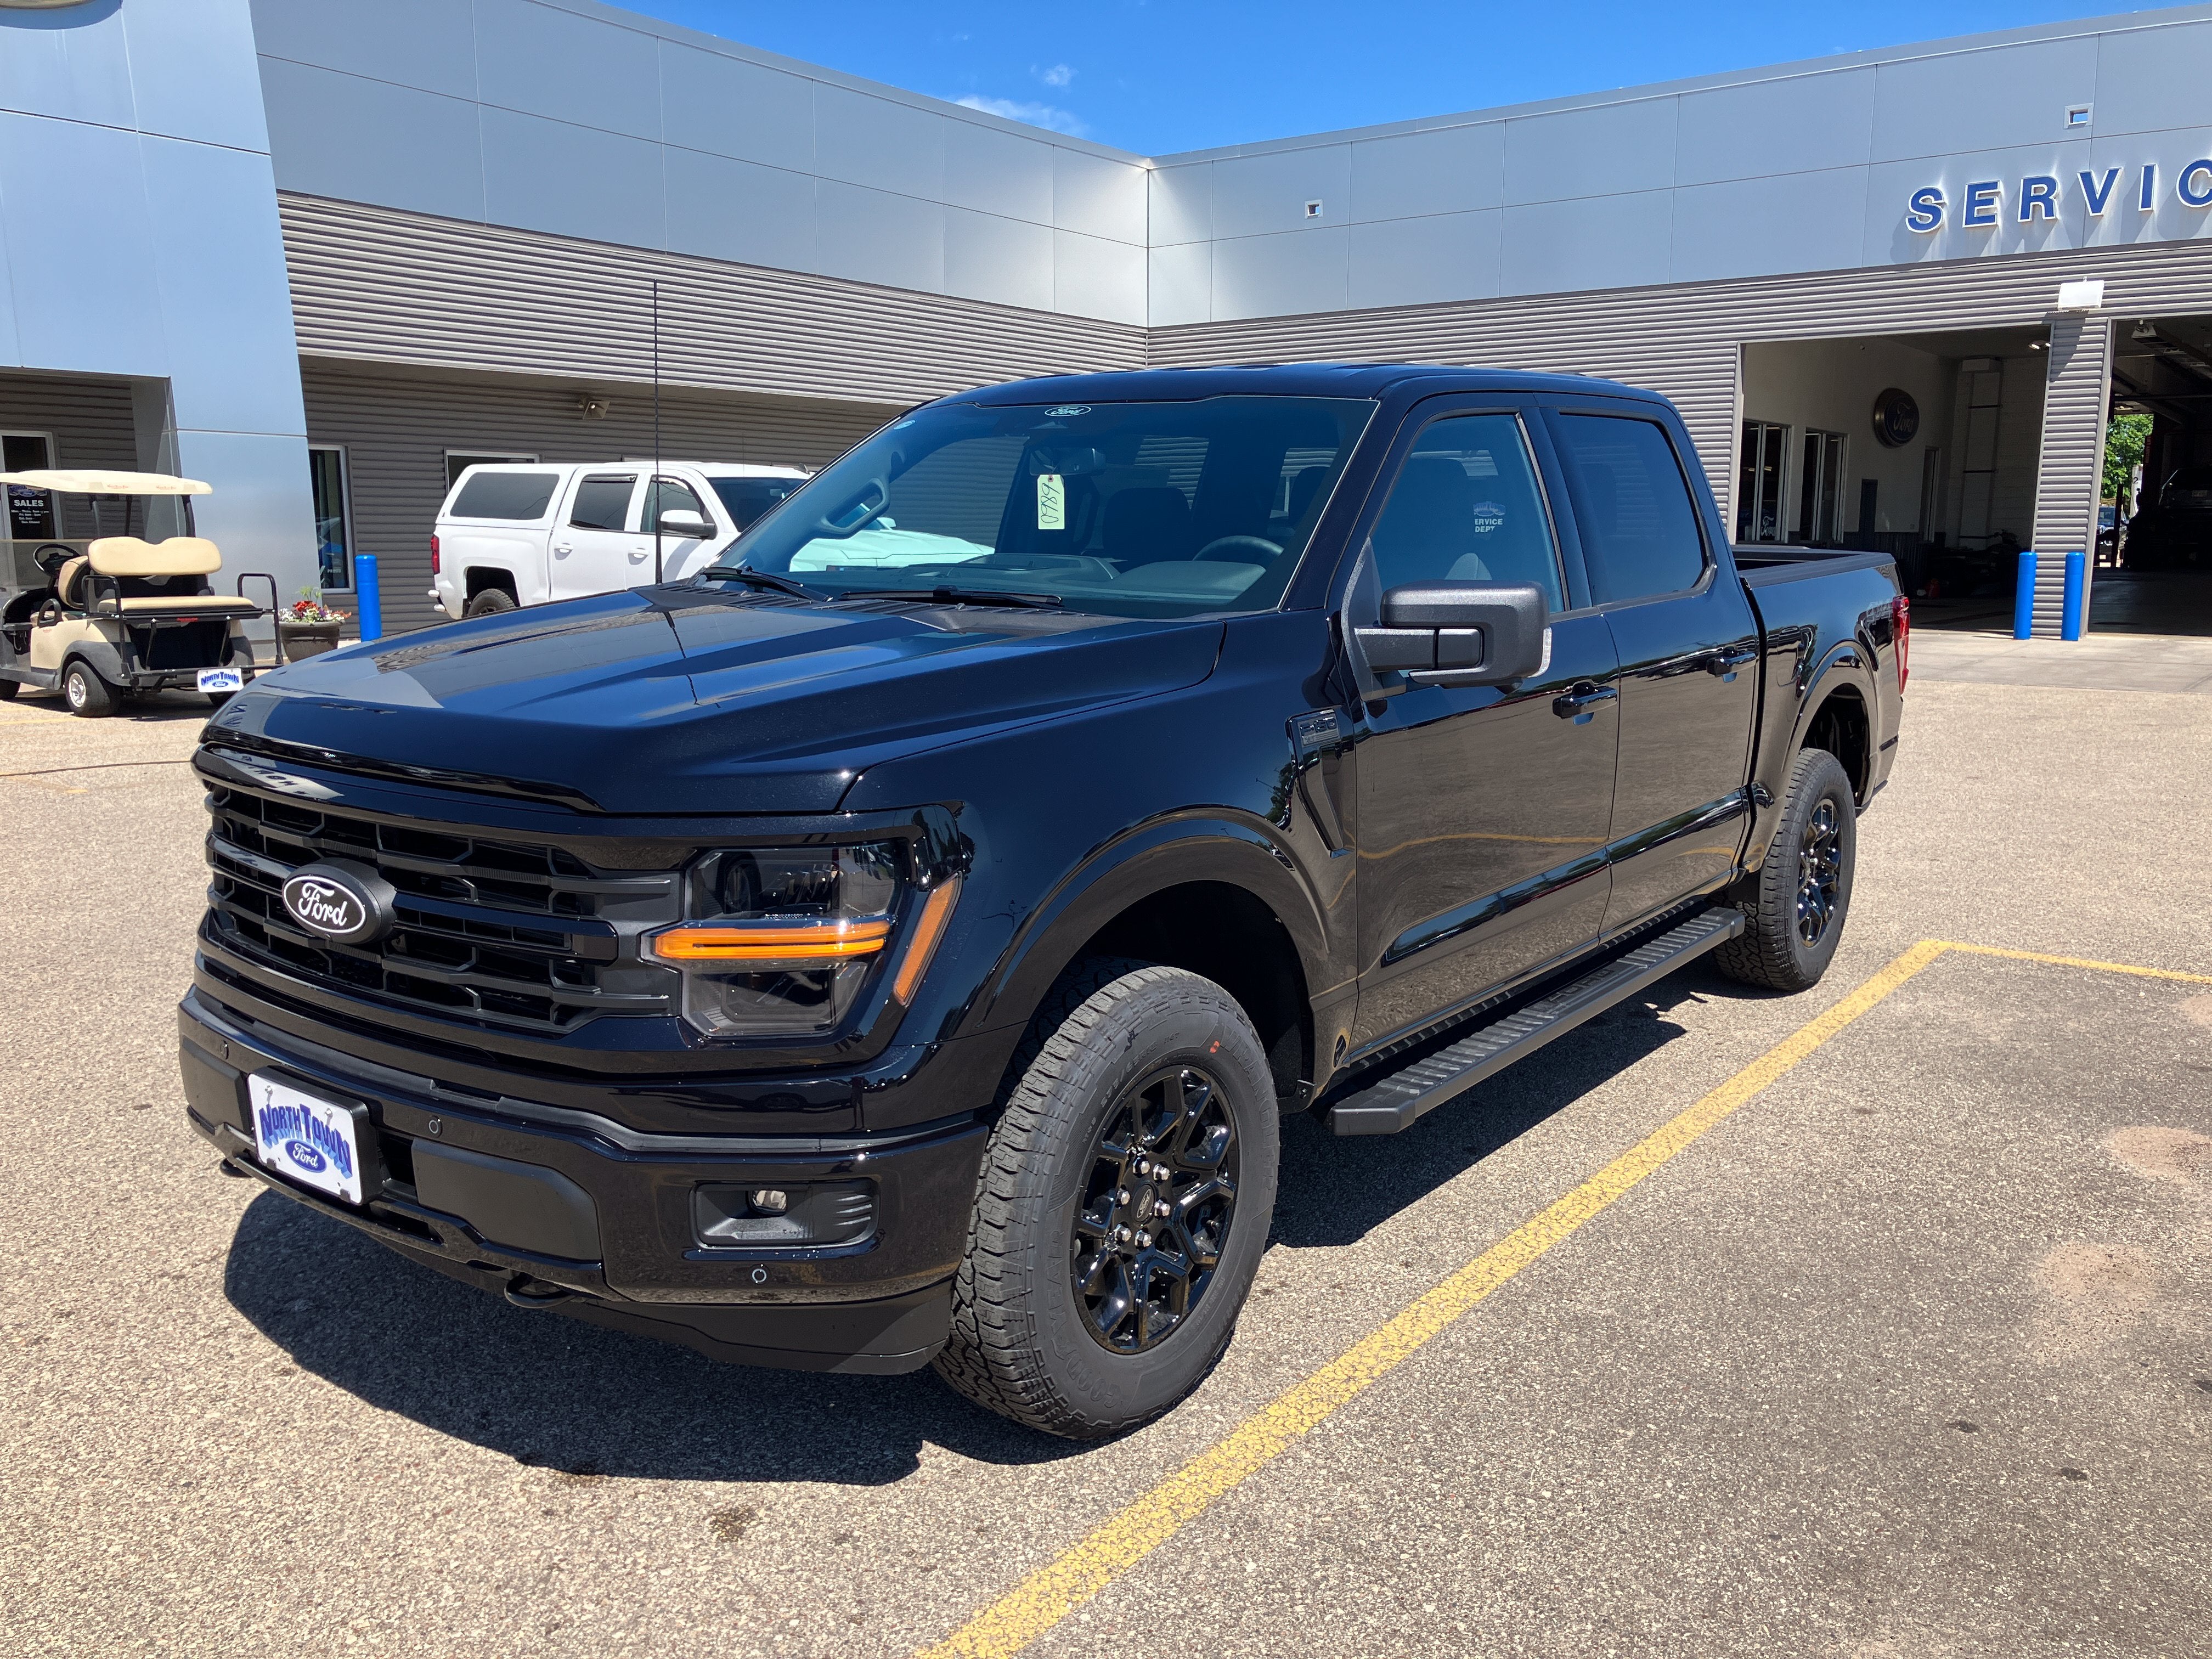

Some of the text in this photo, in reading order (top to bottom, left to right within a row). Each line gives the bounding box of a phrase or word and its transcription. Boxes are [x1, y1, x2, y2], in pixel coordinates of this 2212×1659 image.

[1905, 158, 2212, 233] SERVIC
[1051, 406, 1084, 415] Ford
[298, 882, 348, 926] Ford
[292, 1143, 319, 1168] Ford
